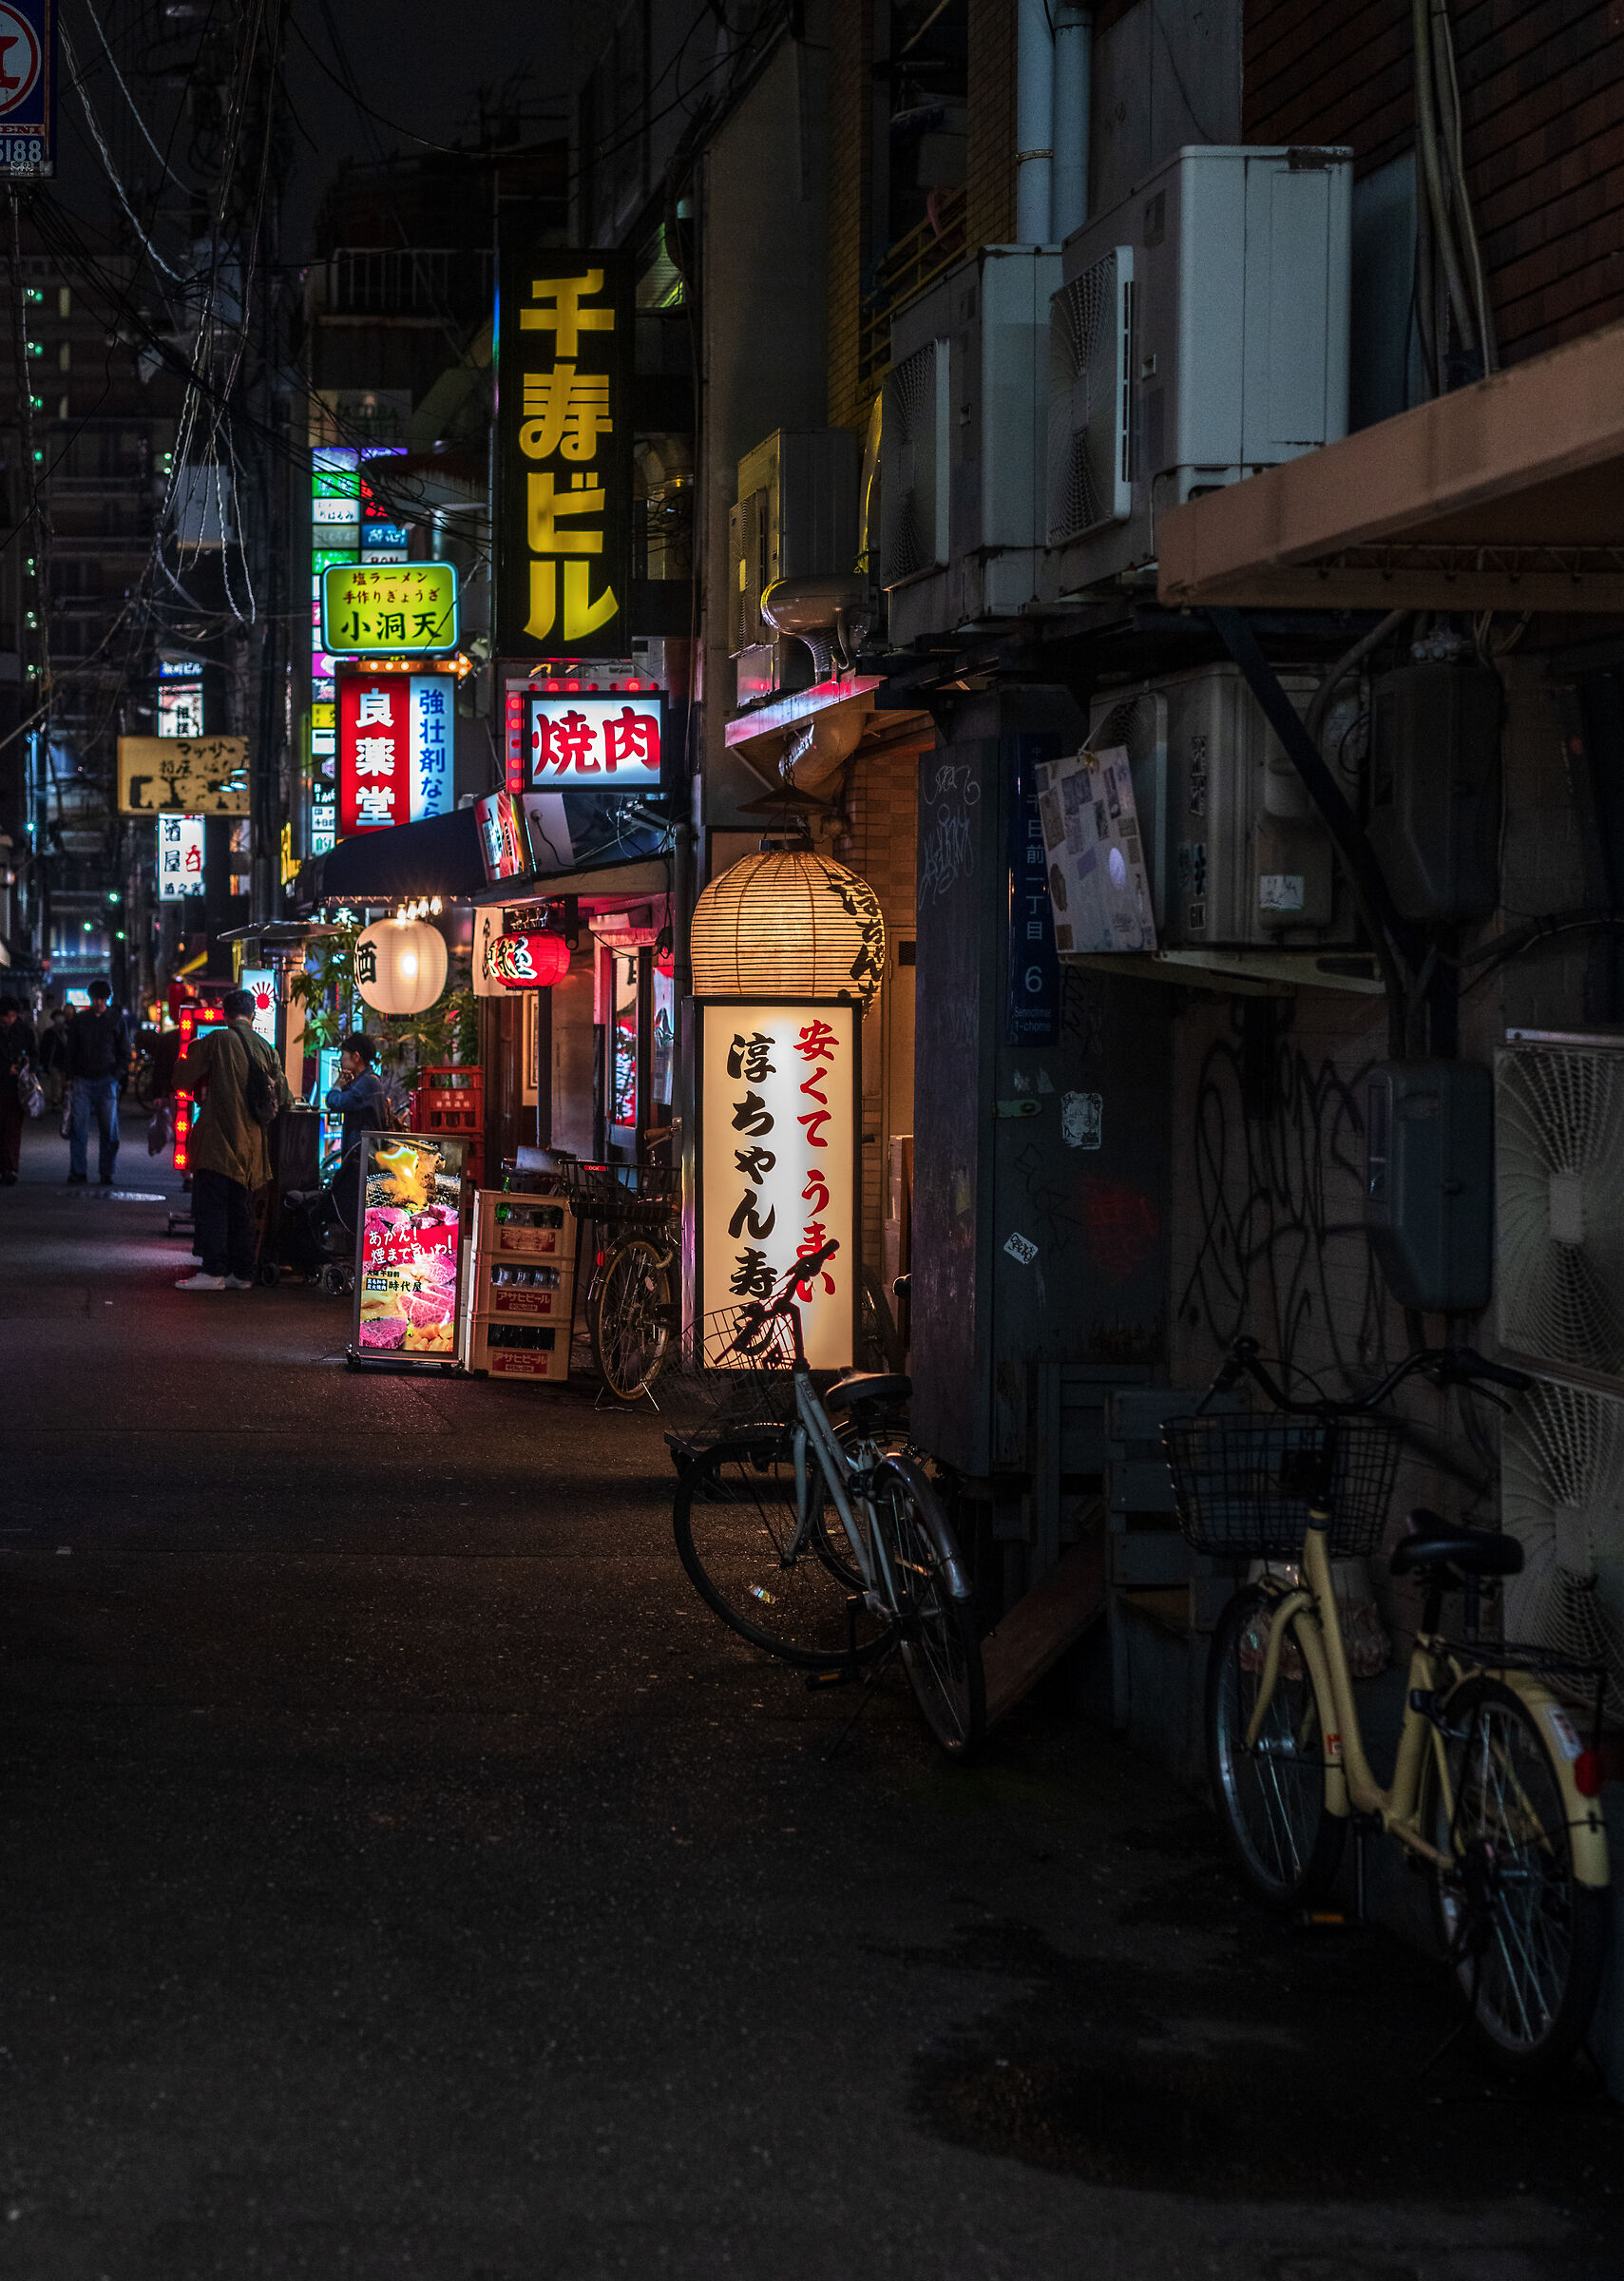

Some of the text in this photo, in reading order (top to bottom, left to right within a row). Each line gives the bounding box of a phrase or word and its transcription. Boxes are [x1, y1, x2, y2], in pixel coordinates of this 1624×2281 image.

[519, 269, 620, 641] 千寿ビル
[353, 572, 428, 585] 塩ラーメン
[343, 588, 440, 604] 手作りぎょうざ
[341, 610, 442, 642] 小洞天
[532, 706, 661, 776] 焼肉
[355, 687, 395, 826] 良薬堂
[1024, 967, 1042, 992] 6
[388, 1280, 423, 1294] 時代屋
[498, 1291, 551, 1305] アサヒビール
[493, 1351, 548, 1366] アサヒビール
